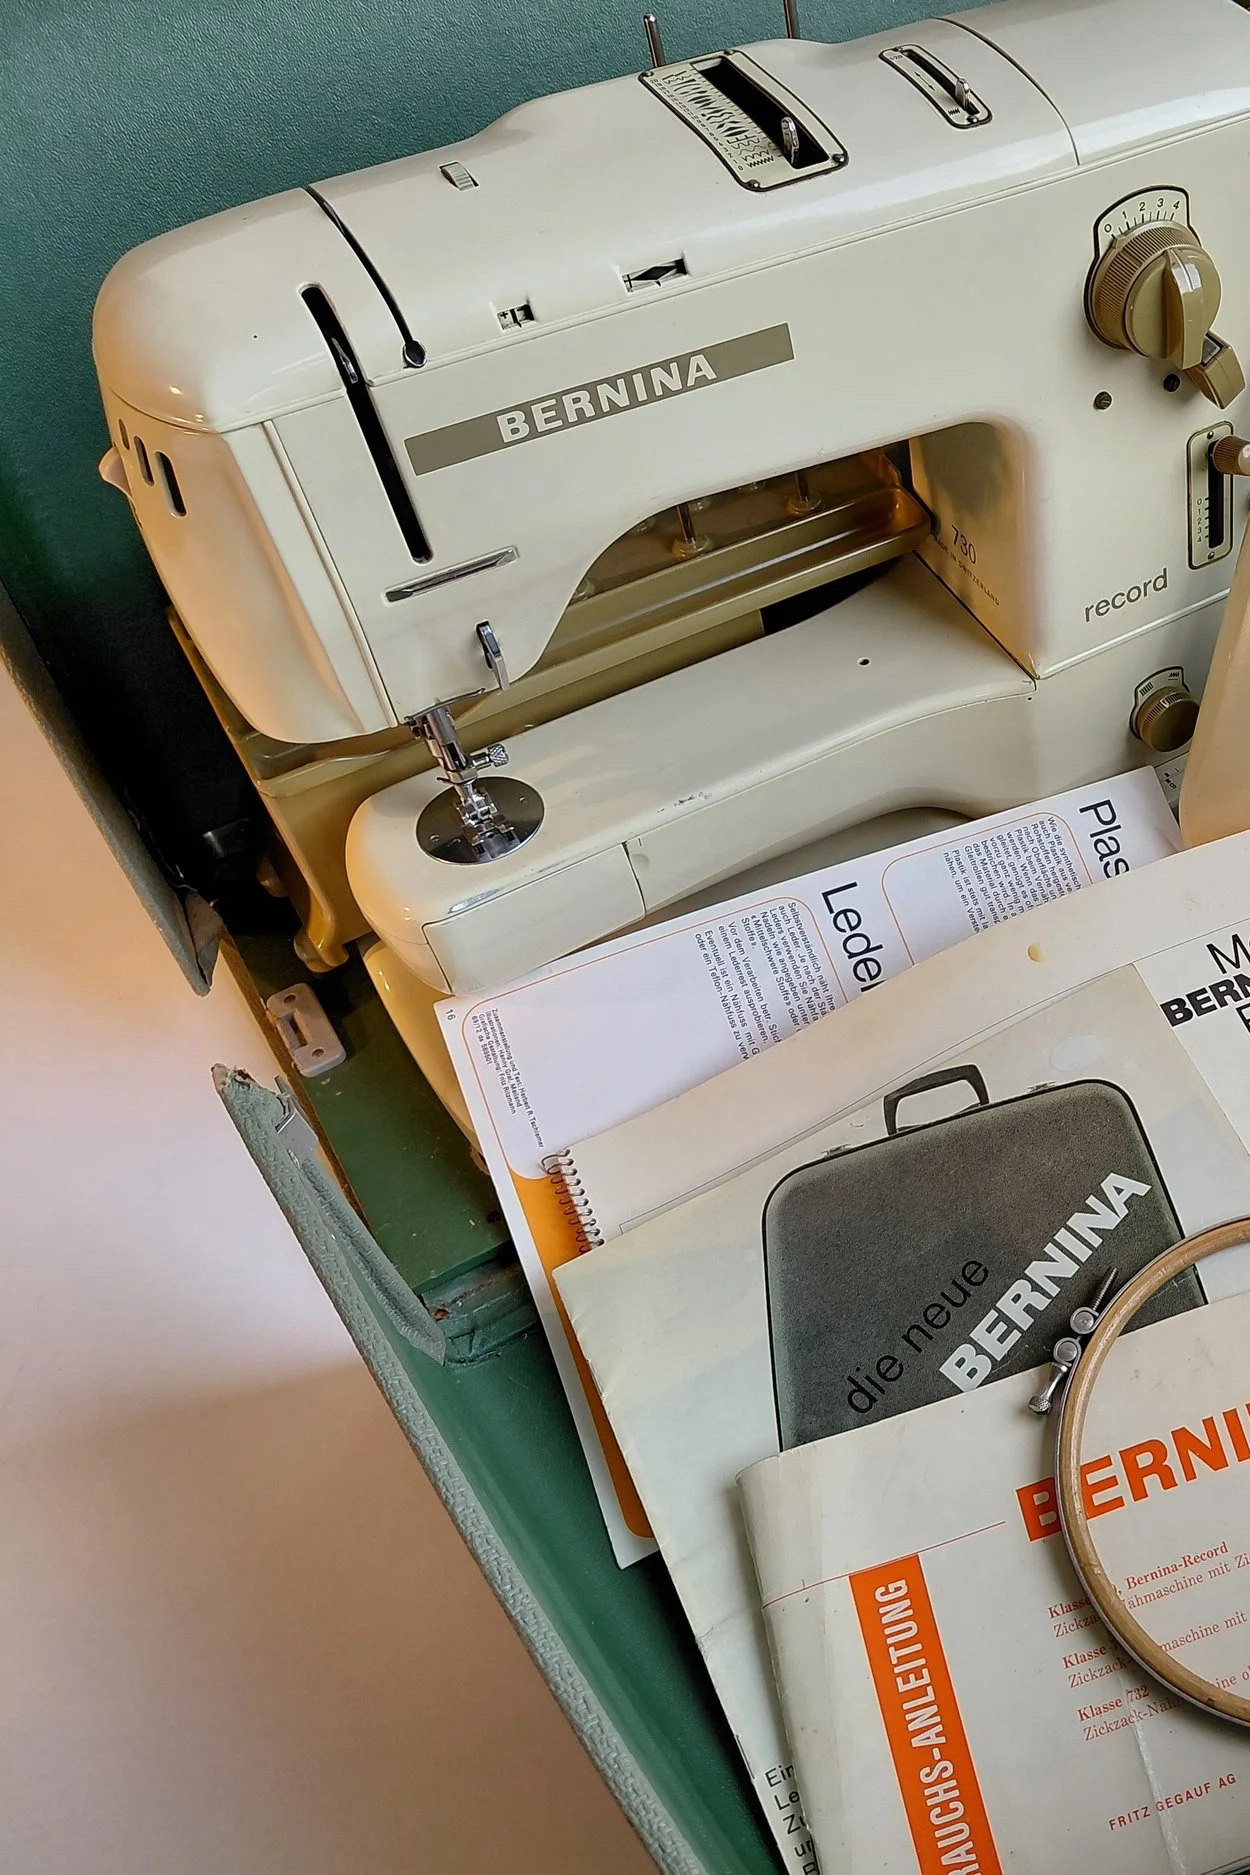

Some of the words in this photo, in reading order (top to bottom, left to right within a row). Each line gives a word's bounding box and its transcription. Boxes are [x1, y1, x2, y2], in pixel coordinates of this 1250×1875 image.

[1103, 223, 1112, 233] 0
[1121, 210, 1127, 219] 1
[1138, 201, 1145, 211] 2
[1156, 197, 1164, 208] 3
[1172, 200, 1180, 209] 4
[496, 354, 717, 443] BERNINA
[952, 525, 976, 564] 730
[1084, 567, 1168, 622] record
[1014, 828, 1029, 854] Plastik
[1025, 854, 1037, 874] beim
[1022, 825, 1035, 845] nach
[1031, 846, 1052, 887] Oberfläche
[1030, 822, 1051, 864] Rohstoffen
[1038, 819, 1051, 839] auch
[1047, 840, 1062, 866] Plastik
[1058, 867, 1068, 881] aus
[1046, 815, 1057, 832] Wie
[1053, 833, 1062, 846] die
[1079, 799, 1129, 878] Plas
[951, 849, 967, 875] Plastik
[962, 875, 971, 886] ist
[967, 887, 979, 906] stets
[975, 907, 986, 920] mit
[964, 845, 984, 885] Gleitrollen
[979, 885, 991, 900] gut
[972, 842, 982, 856] das
[978, 857, 997, 889] Material
[992, 890, 1006, 913] durch
[980, 839, 1001, 879] bestrichen
[1006, 901, 1014, 910] In
[989, 836, 1002, 858] vorzu
[997, 859, 1010, 878] ganz
[1007, 879, 1021, 904] wenig
[1007, 861, 1025, 889] genügt
[1020, 889, 1028, 899] es
[1019, 862, 1032, 886] Wenn
[1029, 887, 1039, 902] das
[954, 879, 963, 893] um
[960, 893, 969, 906] ein
[966, 906, 980, 934] Verste
[704, 929, 725, 966] Eventuell
[717, 925, 732, 949] einem
[728, 950, 748, 987] Lederrest
[719, 966, 729, 978] ist
[727, 920, 738, 935] Vor
[733, 937, 745, 955] dem
[741, 955, 763, 1002] Verarbeiten
[759, 910, 775, 939] Nadeln
[771, 940, 782, 956] wie
[778, 957, 800, 1002] angegeben
[796, 1003, 810, 1024] unter
[768, 907, 784, 934] Leders
[780, 935, 802, 979] verwenden
[798, 980, 808, 994] Sie
[778, 905, 792, 925] auch
[796, 950, 808, 964] Je
[802, 964, 816, 985] nach
[810, 986, 821, 999] der
[787, 901, 821, 972] Selbstverständlich
[816, 974, 829, 993] näht
[824, 993, 835, 1011] Ihre
[694, 932, 707, 950] oder
[702, 952, 712, 965] ein
[708, 965, 737, 1028] Teflon-Nähfuss
[732, 1029, 741, 1040] zu
[723, 979, 734, 992] ein
[729, 993, 747, 1027] Nähfuss
[444, 1008, 456, 1020] 16
[744, 1031, 755, 1046] mit
[787, 1007, 800, 1026] oder
[938, 1172, 1152, 1393] BERNINA
[847, 1355, 904, 1414] die
[901, 1260, 989, 1353] neue
[1126, 1541, 1228, 1589] Bernina-Record
[1207, 1561, 1231, 1579] mit
[1223, 1611, 1247, 1628] mit
[1060, 1642, 1108, 1670] Klasse
[1077, 1698, 1122, 1721] Klasse
[1126, 1683, 1151, 1699] 732
[774, 1791, 800, 1810] Le
[1109, 1806, 1150, 1830] FRITZ
[1156, 1782, 1211, 1811] GEGAUF
[1218, 1774, 1236, 1788] AG
